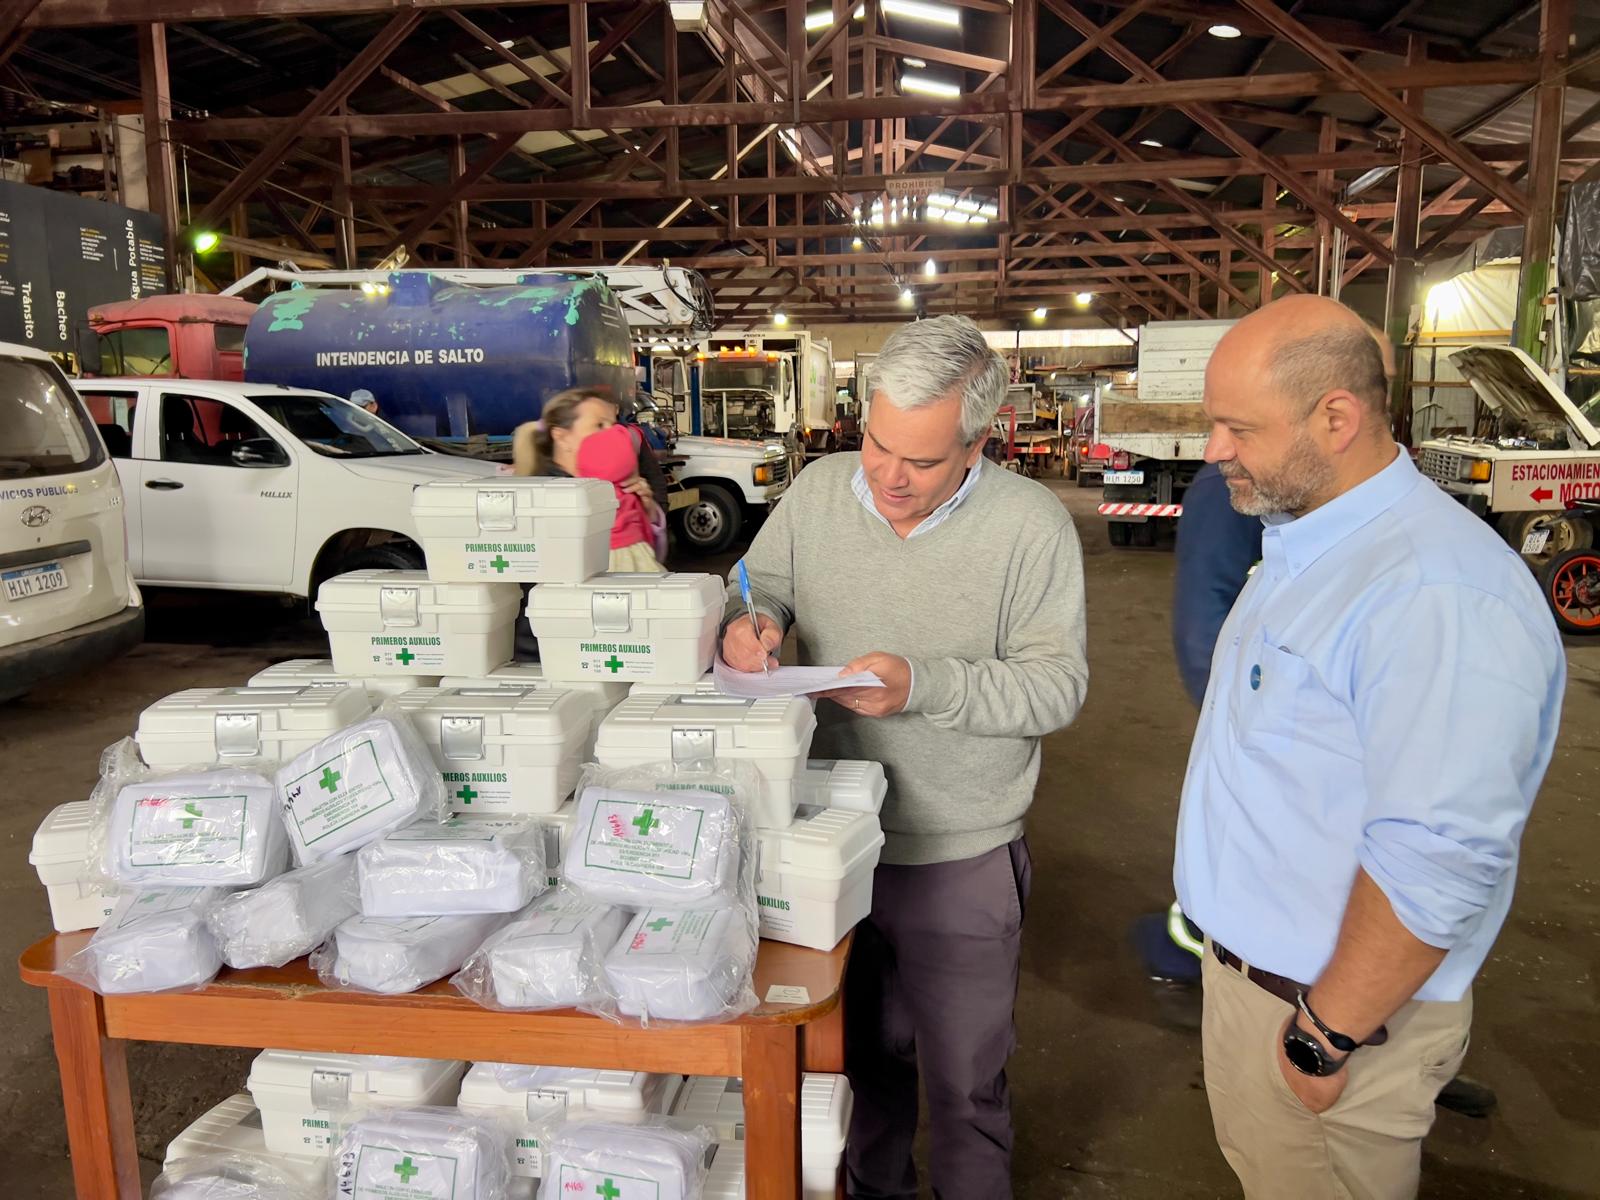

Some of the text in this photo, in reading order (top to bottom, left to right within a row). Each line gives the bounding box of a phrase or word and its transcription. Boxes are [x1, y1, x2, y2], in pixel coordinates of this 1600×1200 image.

[125, 219, 137, 266] Potable
[21, 282, 34, 339] Tránsito
[55, 291, 68, 341] Bacheo
[316, 348, 484, 366] INTENDENCIA DE SALTO
[465, 543, 536, 553] PRIMEROS AUXILIOS
[35, 571, 63, 591] 1209
[371, 636, 441, 646] PRIMEROS AUXILIOS
[580, 643, 651, 654] PRIMEROS AUXILIOS
[442, 772, 507, 782] MEROS AUXILIOS
[757, 896, 790, 910] AUXILIOS
